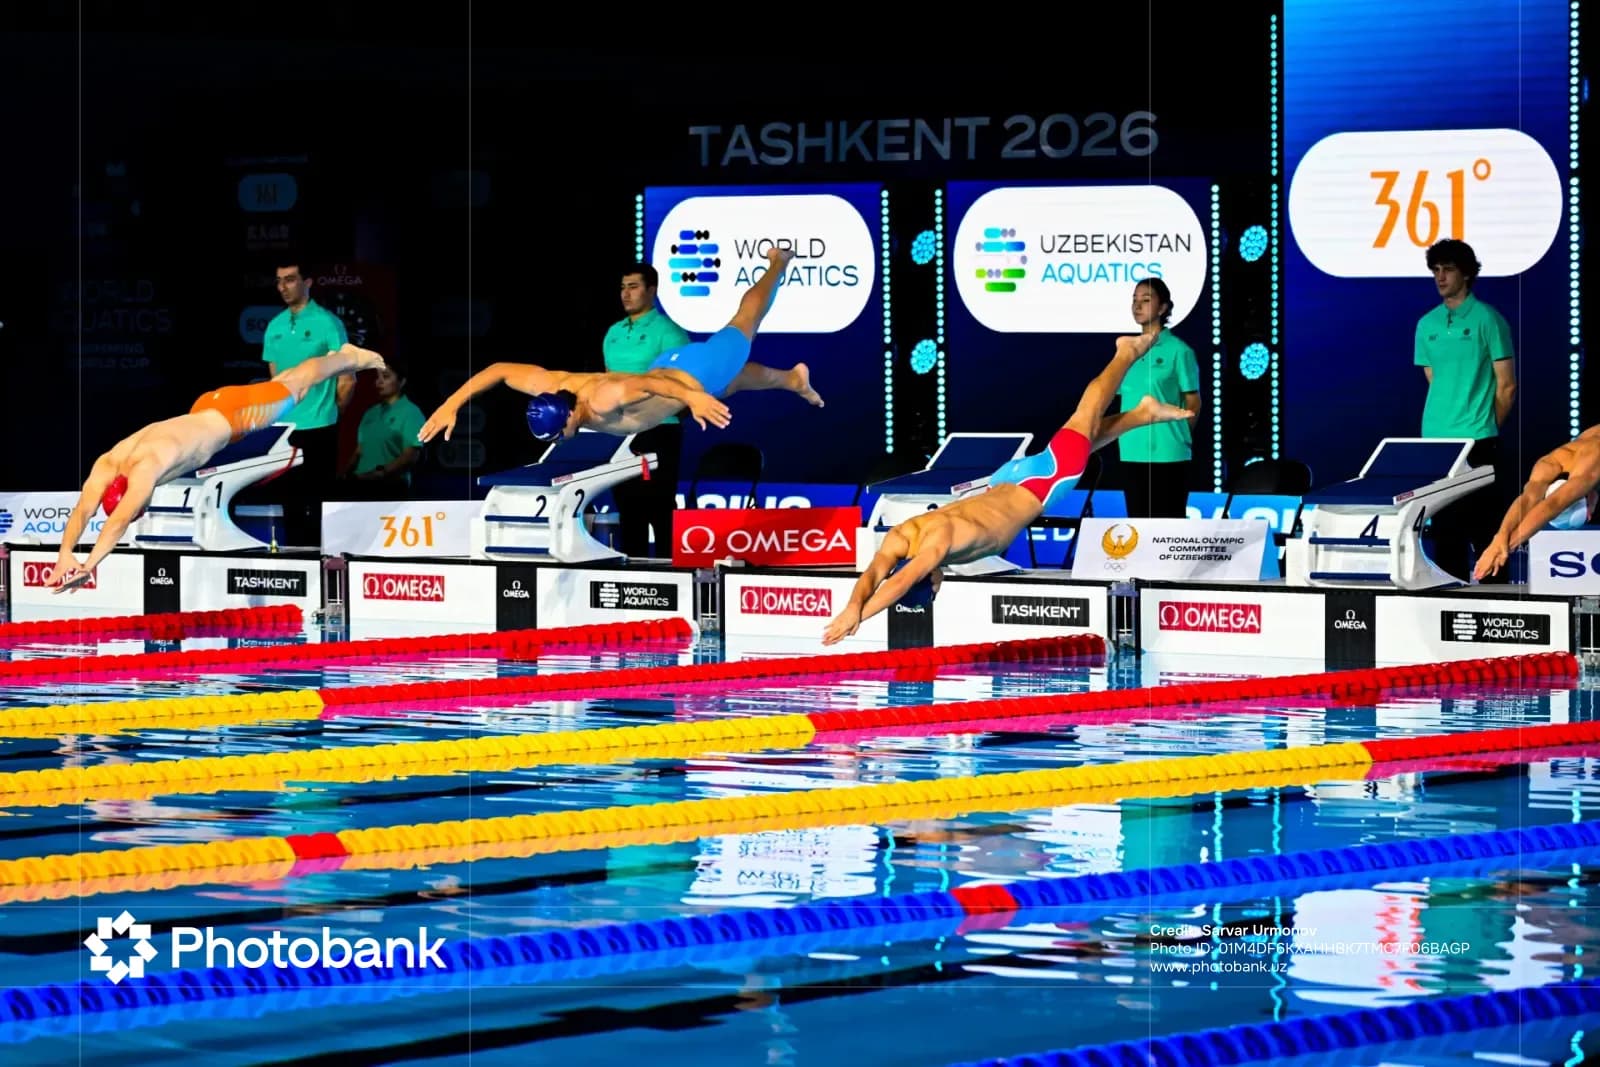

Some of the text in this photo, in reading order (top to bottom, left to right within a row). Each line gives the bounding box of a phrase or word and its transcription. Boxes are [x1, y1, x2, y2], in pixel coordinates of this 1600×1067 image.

[689, 111, 1159, 167] TASHKENT 2026
[1369, 158, 1492, 248] 361°
[734, 238, 826, 260] WORLD
[1040, 233, 1192, 253] UZBEKISTAN
[734, 265, 859, 287] AATICS
[1041, 262, 1163, 285] AQUATICS
[182, 487, 191, 508] 1
[215, 481, 223, 508] 1
[573, 488, 585, 518] 2
[23, 507, 97, 519] WOR
[535, 495, 547, 518] 2
[22, 521, 106, 533] AQUIC
[379, 511, 446, 547] 361°
[1360, 515, 1379, 538] 4
[1413, 506, 1425, 531] 4
[727, 529, 852, 552] OMEGA
[1168, 545, 1227, 553] COMMITTEE
[1549, 550, 1600, 578] S
[150, 577, 174, 585] OMEGA
[235, 576, 300, 588] TASHKENT
[383, 578, 443, 599] OMEGA
[503, 589, 530, 599] OMEGA
[623, 587, 658, 597] WORLD
[623, 597, 669, 607] AQUATICS
[763, 593, 831, 613] OMEGA
[1001, 603, 1081, 619] TASHKENT
[1184, 607, 1261, 630] OMEGA
[1334, 620, 1367, 630] OMEGA
[1482, 618, 1525, 628] WORLD
[1482, 628, 1539, 640] AQUATICS
